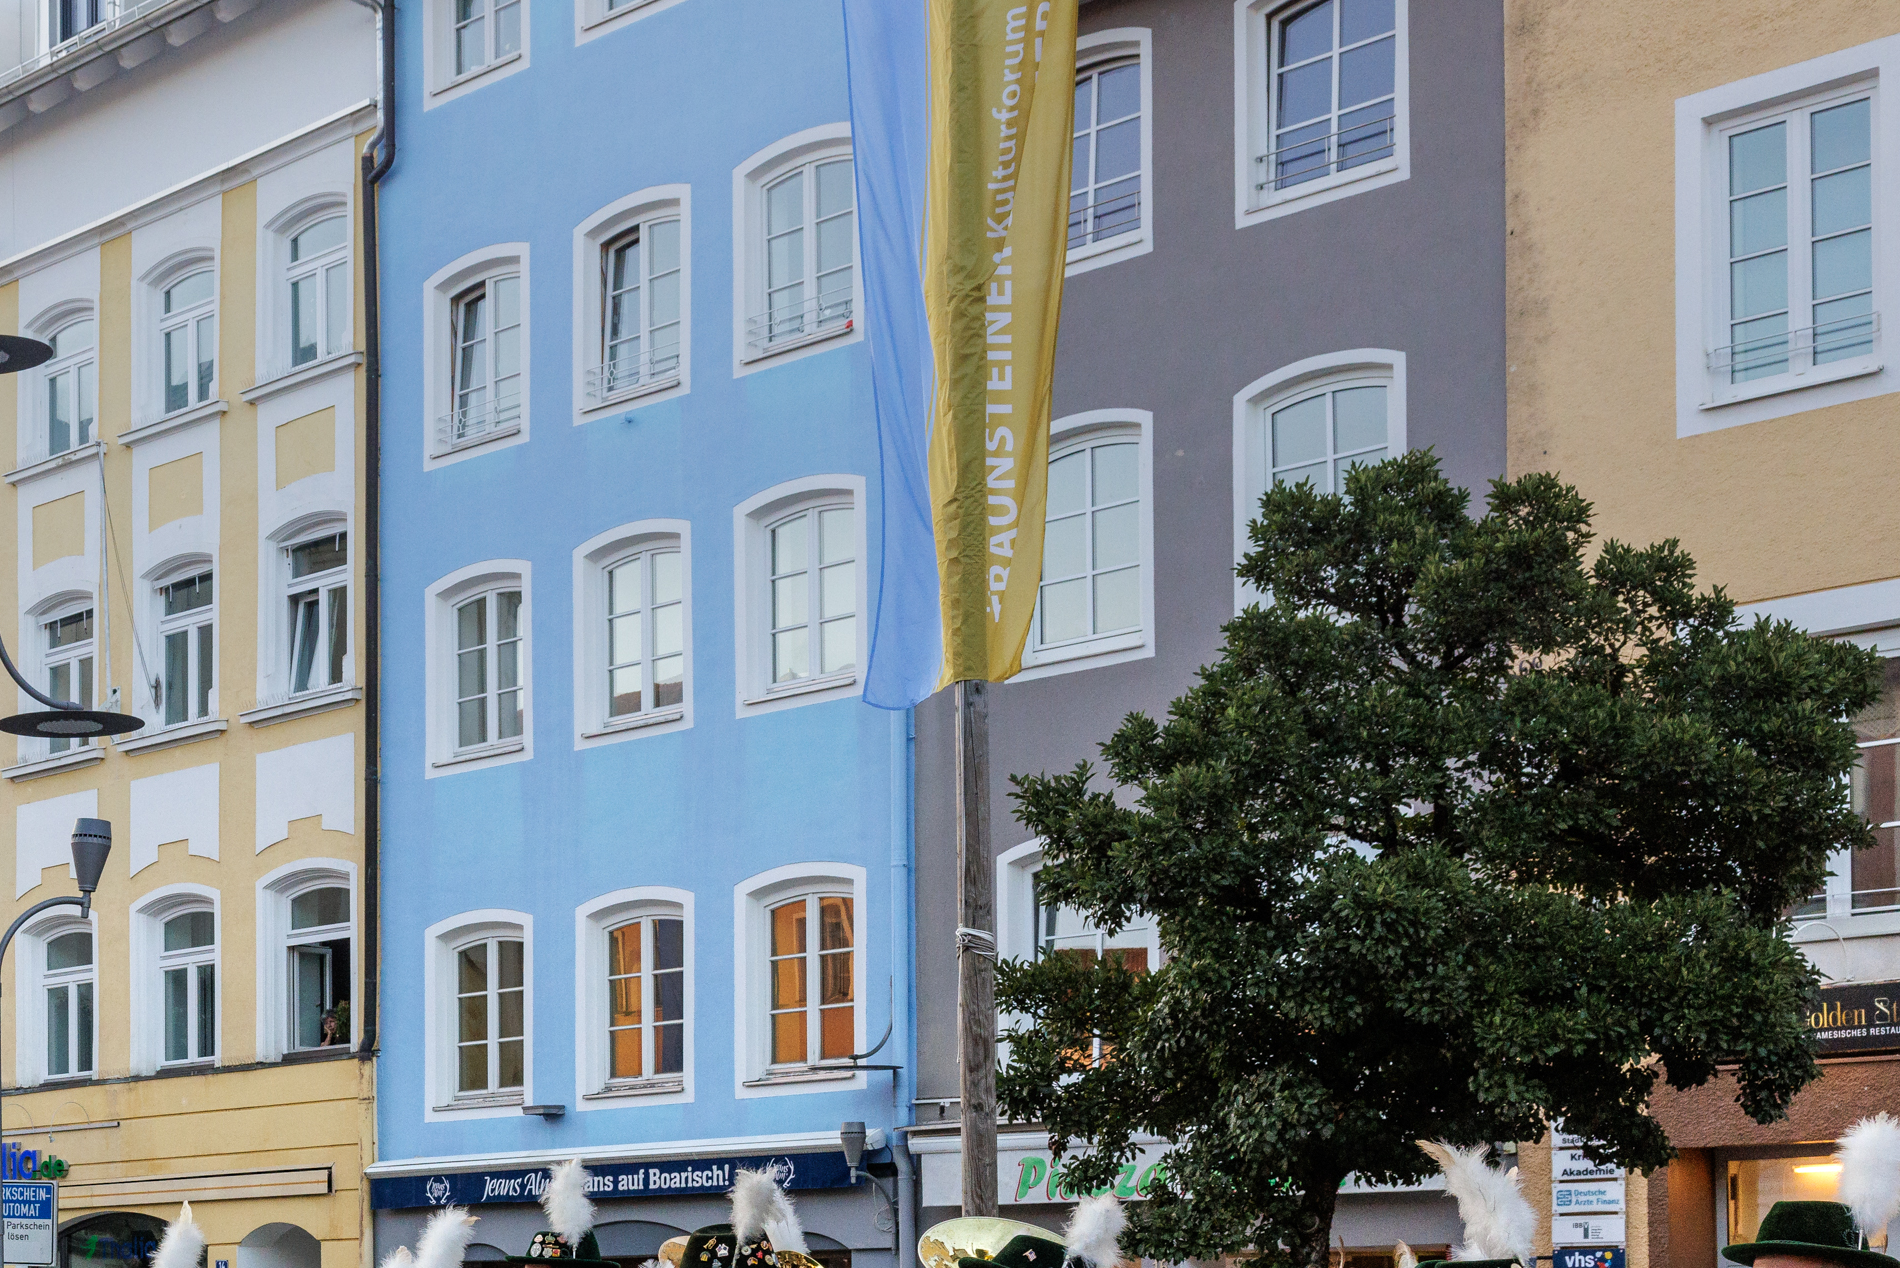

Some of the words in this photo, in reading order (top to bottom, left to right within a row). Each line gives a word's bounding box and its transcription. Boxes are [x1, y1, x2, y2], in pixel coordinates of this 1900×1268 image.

[986, 4, 1028, 238] Kulturforum
[1874, 997, 1900, 1025] St
[1816, 1029, 1867, 1040] AMESISCHES
[1869, 1026, 1900, 1036] RESTAU
[1562, 1167, 1614, 1176] Akademie
[481, 1176, 522, 1202] Jeans
[584, 1175, 613, 1192] ans
[618, 1169, 644, 1191] auf
[649, 1164, 730, 1190] Boarisch!
[1596, 1198, 1620, 1206] Finanz
[2, 1204, 40, 1217] UTOMAT
[6, 1221, 50, 1231] Parkschein
[7, 1232, 29, 1241] lösen
[1565, 1252, 1595, 1268] vhs
